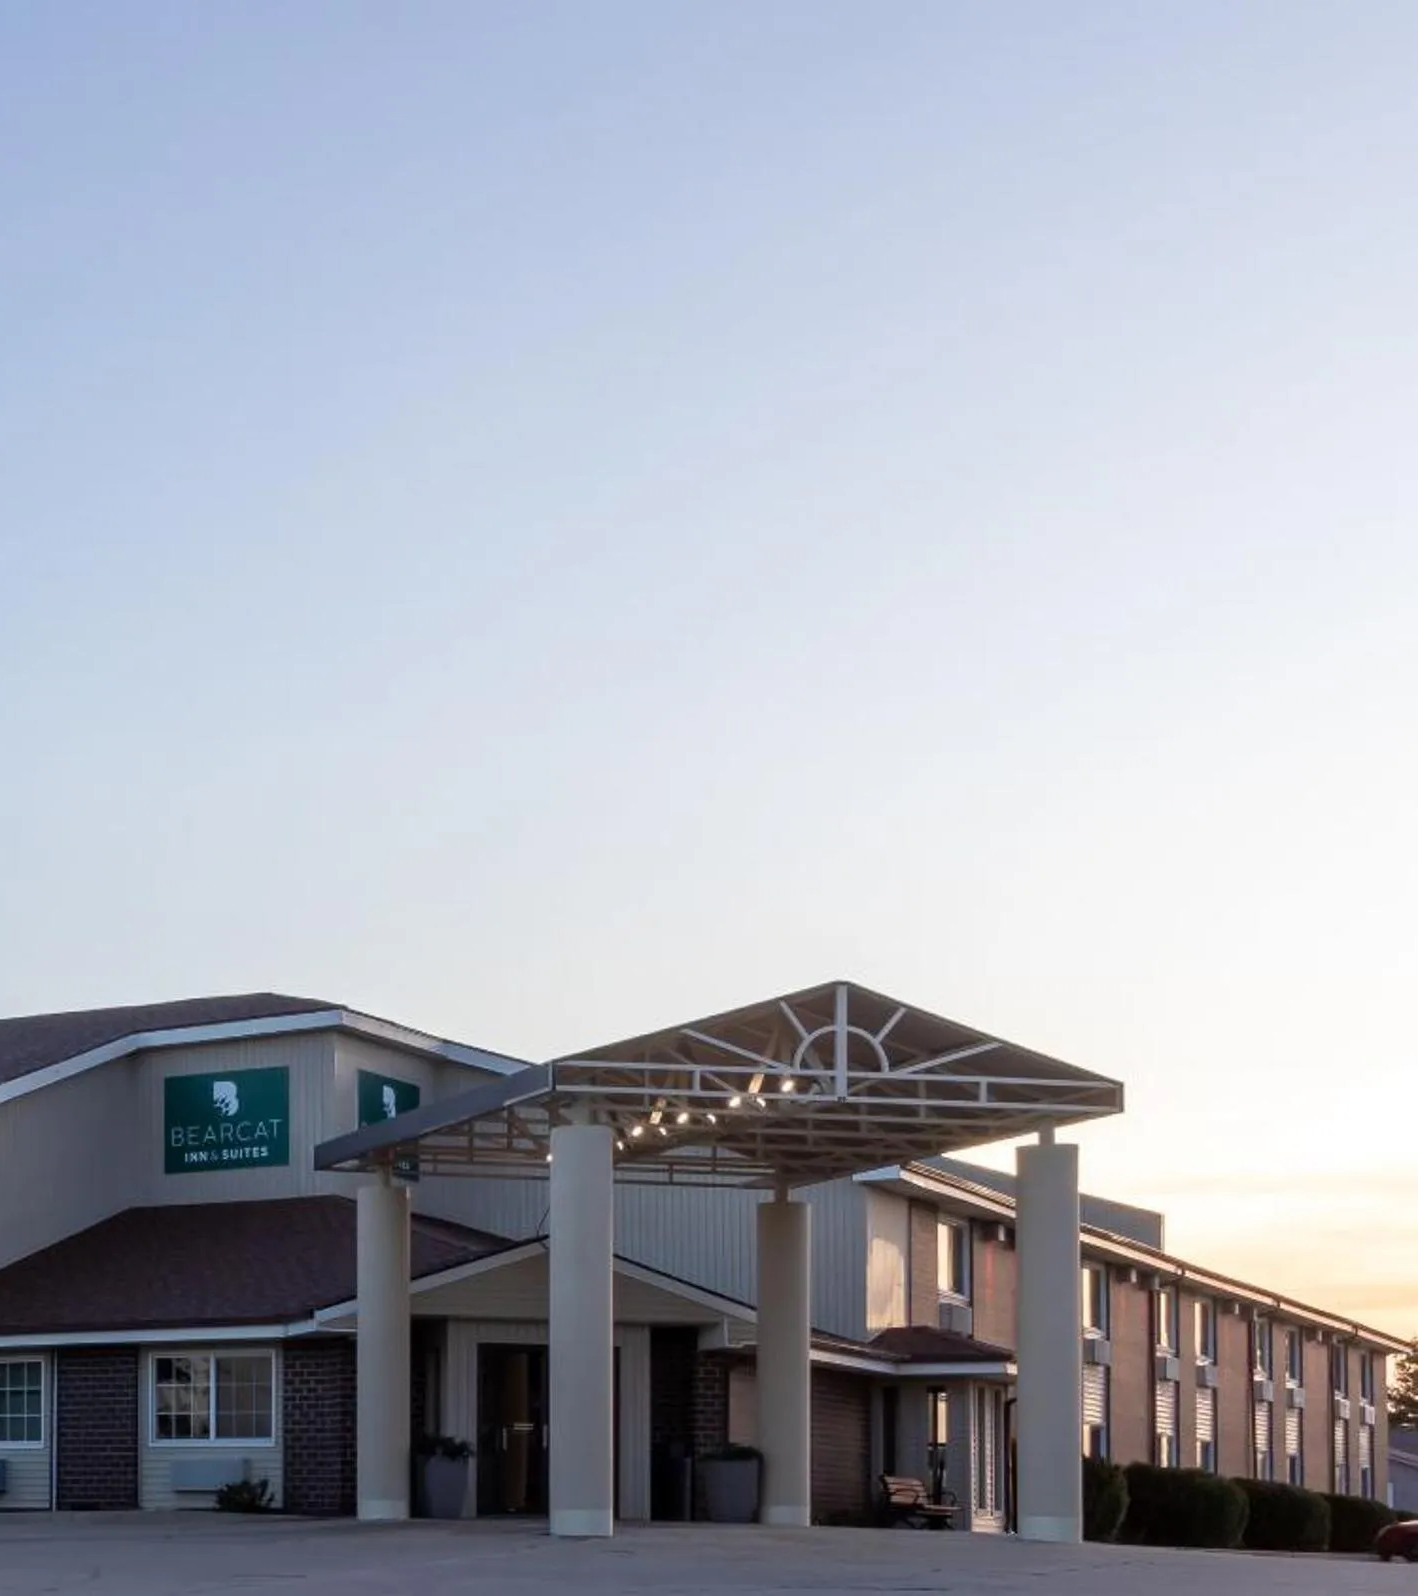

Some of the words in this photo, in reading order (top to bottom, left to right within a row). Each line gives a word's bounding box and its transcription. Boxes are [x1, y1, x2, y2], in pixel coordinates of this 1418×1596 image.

[171, 1118, 282, 1147] BEARCAT
[184, 1150, 207, 1162] INN
[222, 1146, 269, 1160] SUITES
